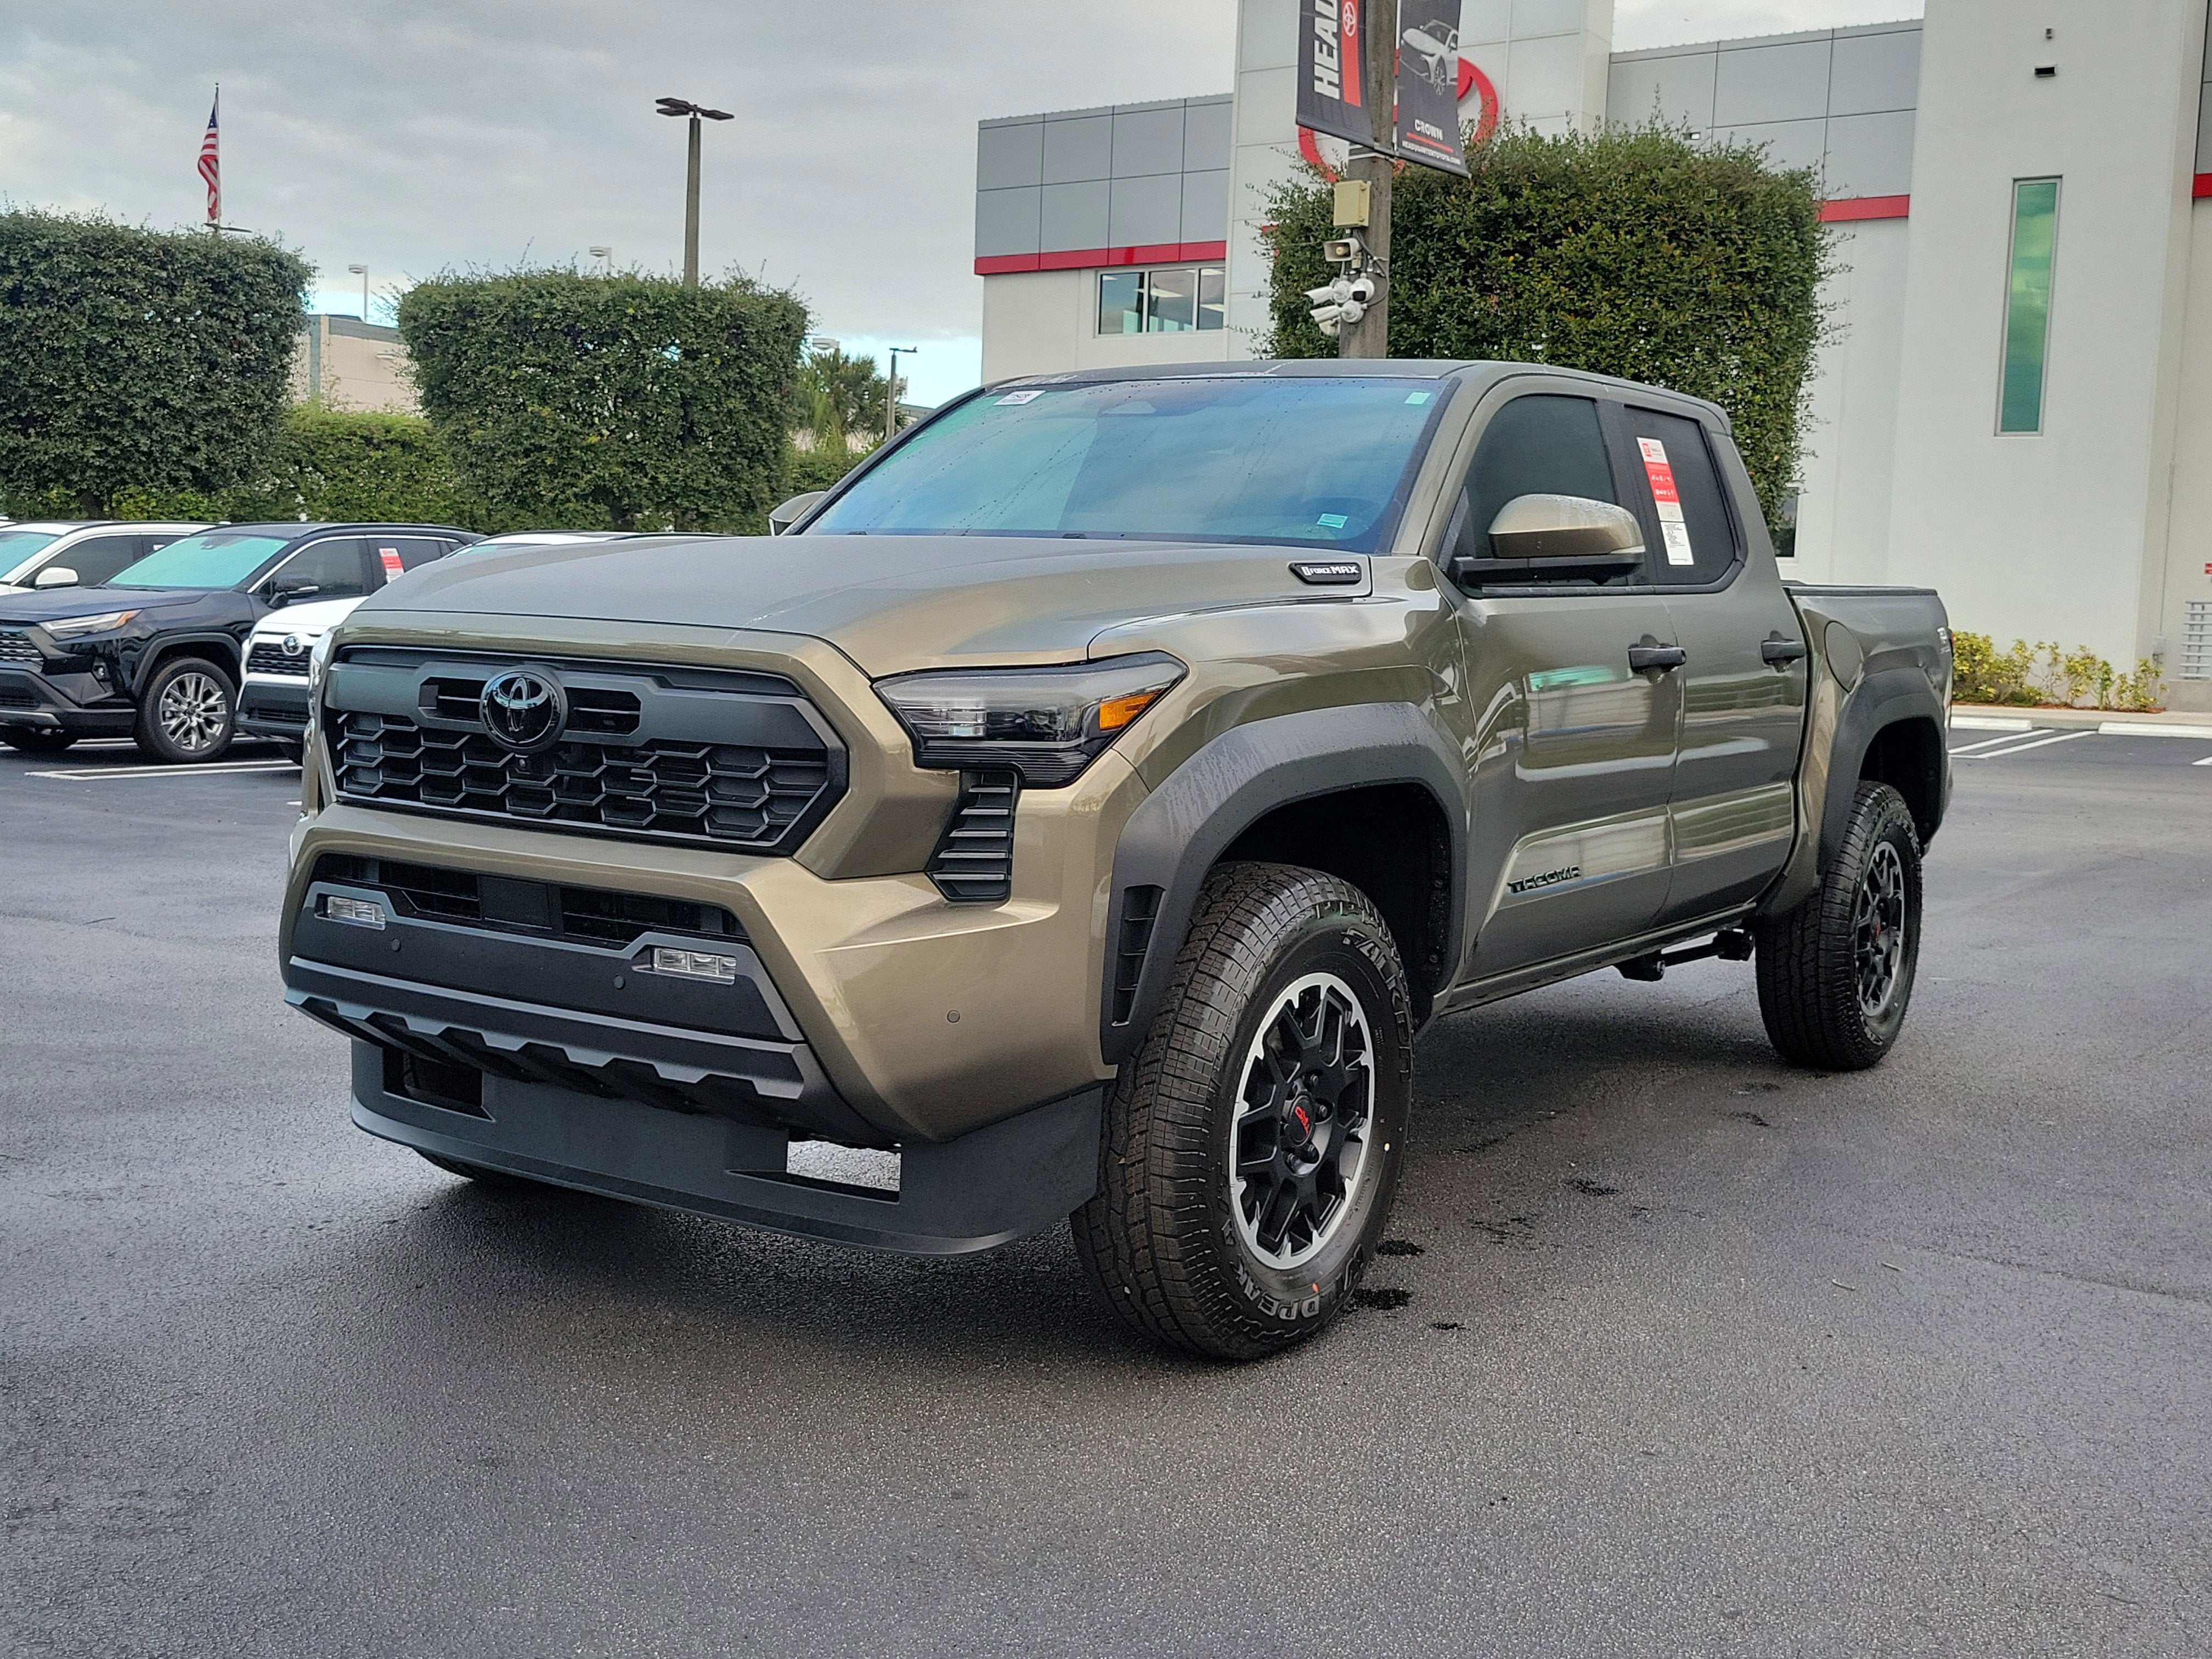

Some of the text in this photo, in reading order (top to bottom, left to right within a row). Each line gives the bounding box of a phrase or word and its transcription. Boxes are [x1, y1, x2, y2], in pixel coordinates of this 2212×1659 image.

[1414, 119, 1443, 141] CROWN
[1330, 566, 1359, 574] MAX
[1508, 865, 1581, 894] TACOMA
